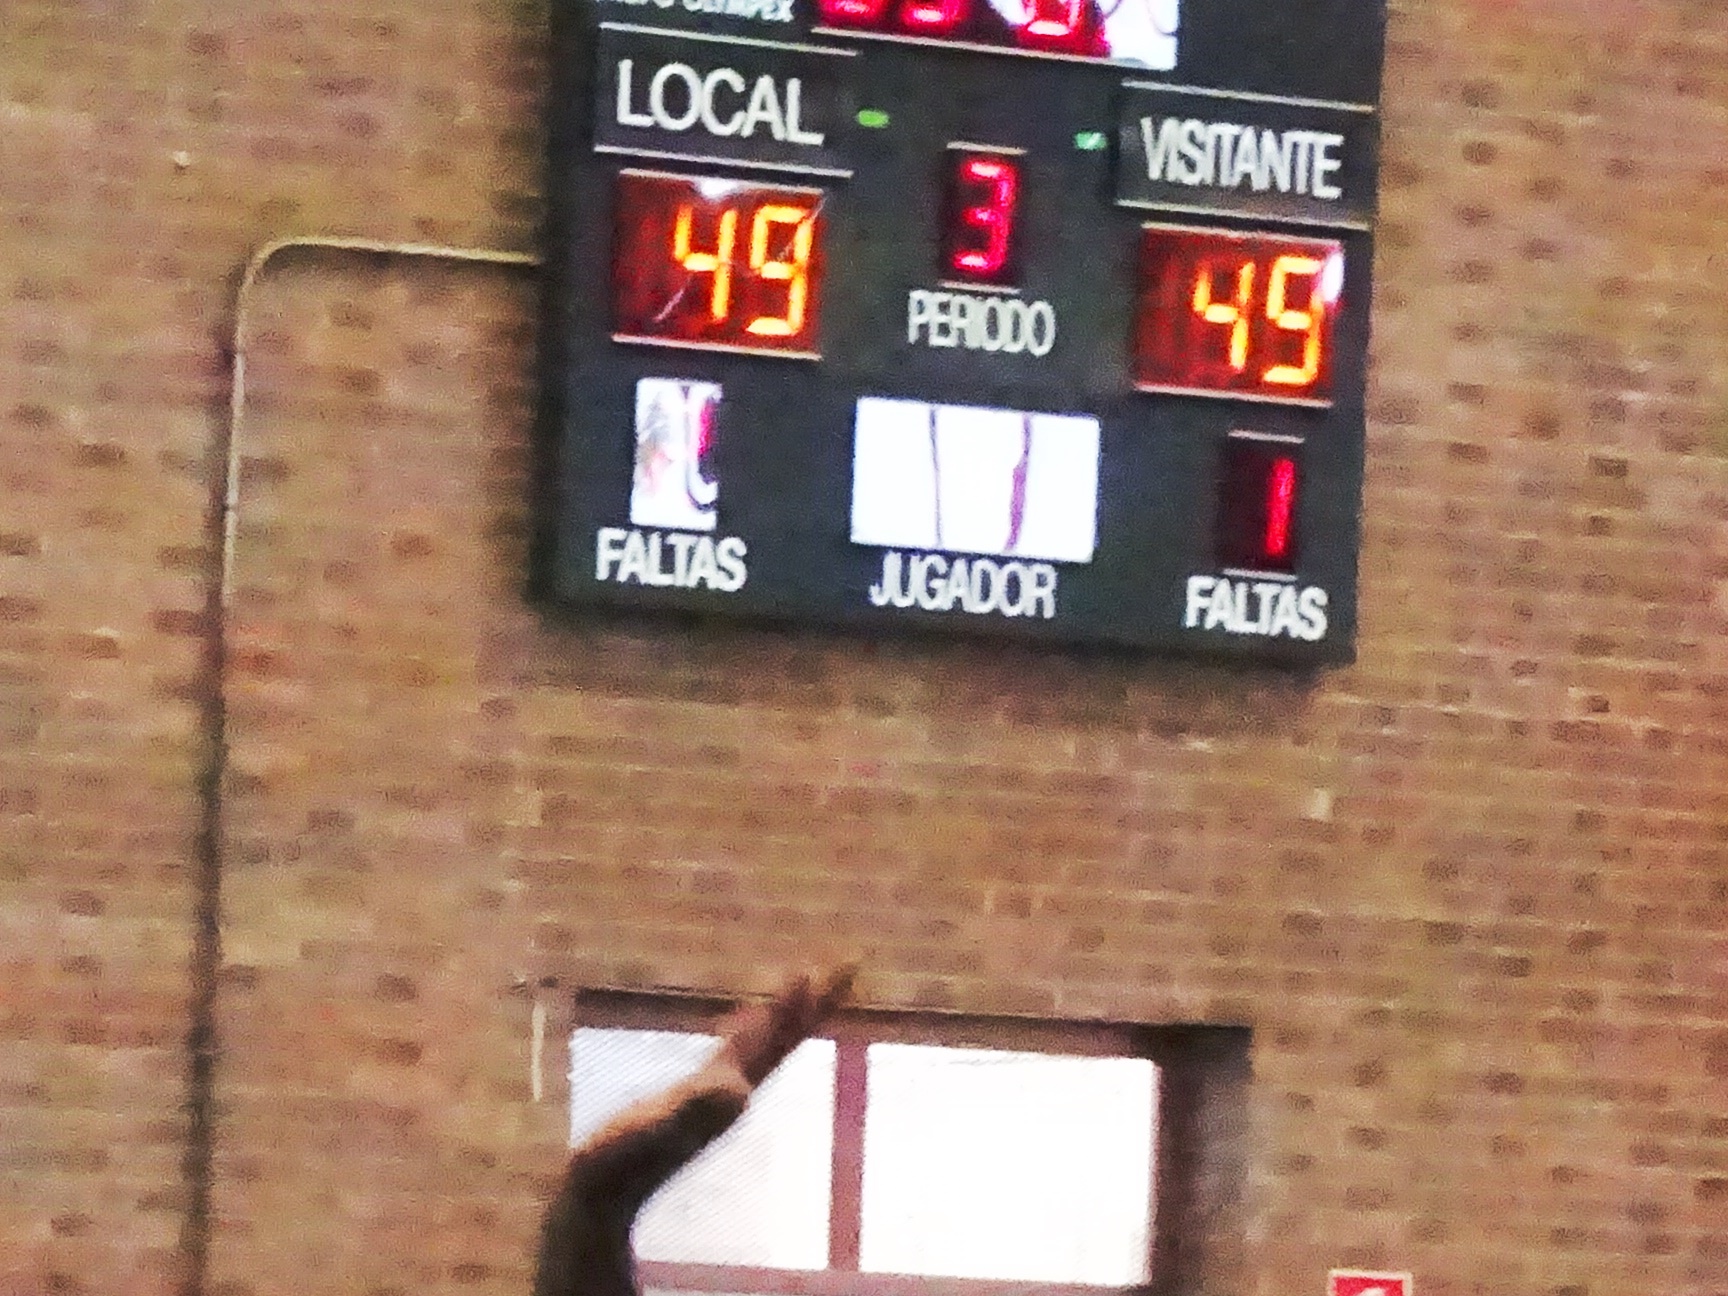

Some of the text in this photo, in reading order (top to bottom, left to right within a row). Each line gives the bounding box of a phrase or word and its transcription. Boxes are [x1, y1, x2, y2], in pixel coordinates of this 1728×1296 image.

[616, 58, 825, 146] LOCAL
[1141, 116, 1344, 199] VISITANTE
[956, 160, 1018, 272] 3
[674, 204, 816, 337] 49
[908, 289, 1056, 356] PERIODO
[1265, 457, 1296, 556] 1
[595, 527, 747, 592] FALTAS
[870, 550, 1056, 619] JUGADOR
[1185, 575, 1329, 641] FALTAS
